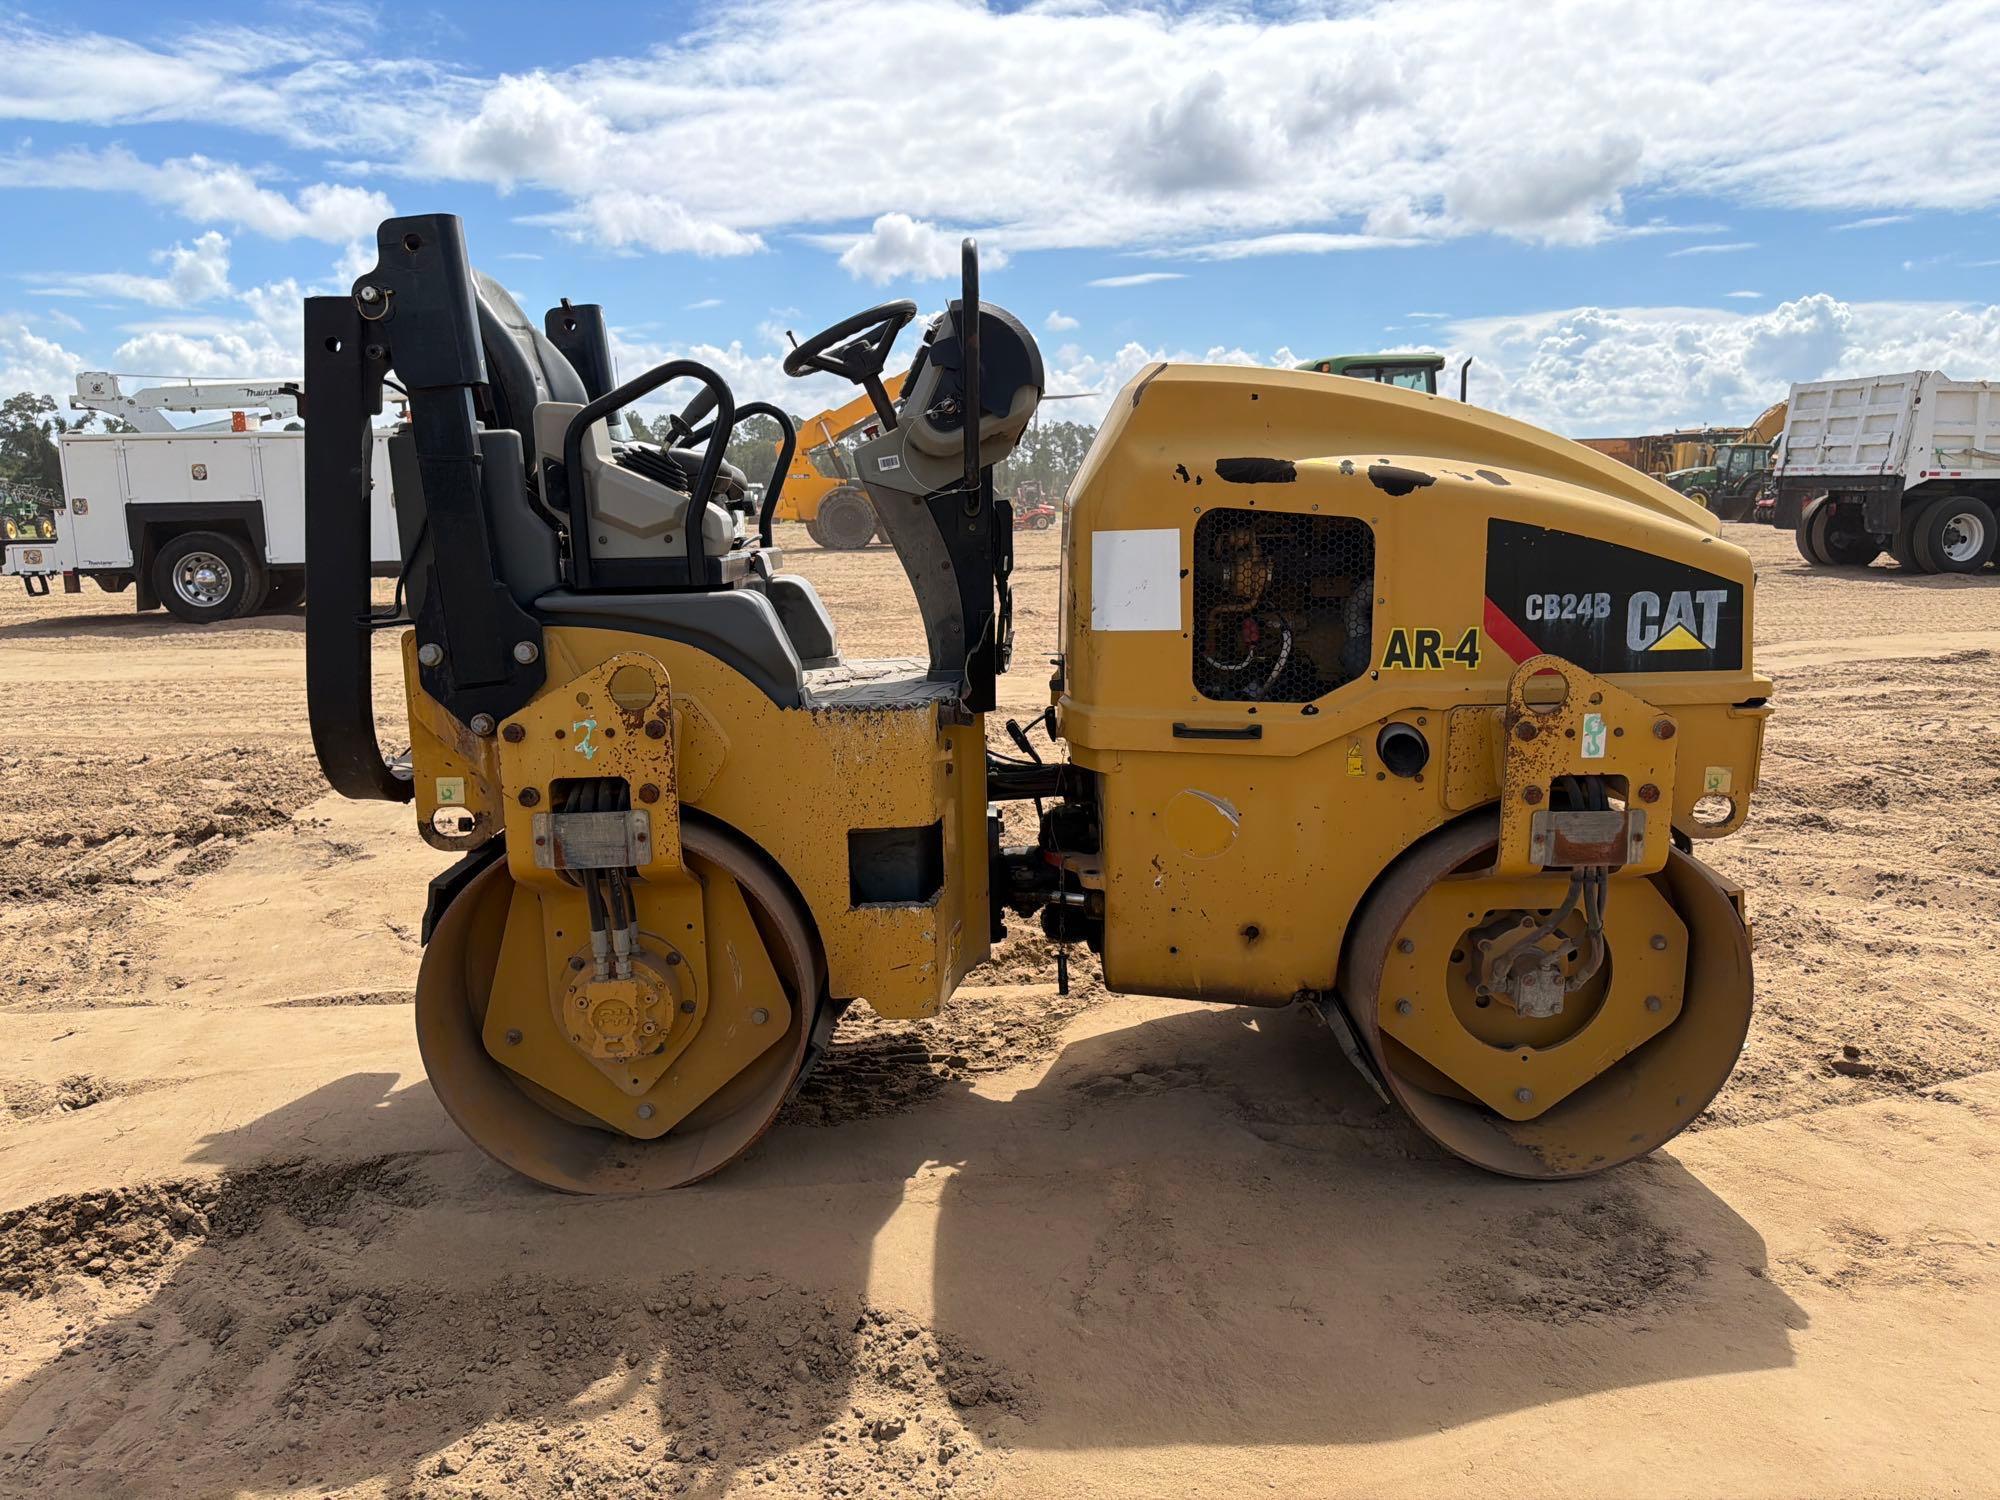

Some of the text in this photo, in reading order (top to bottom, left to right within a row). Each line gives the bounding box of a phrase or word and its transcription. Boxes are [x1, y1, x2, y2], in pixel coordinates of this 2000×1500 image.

[239, 388, 281, 397] Mainta
[1525, 593, 1611, 621] CB24B
[1626, 590, 1728, 651] CAT
[1380, 627, 1481, 670] AR-4
